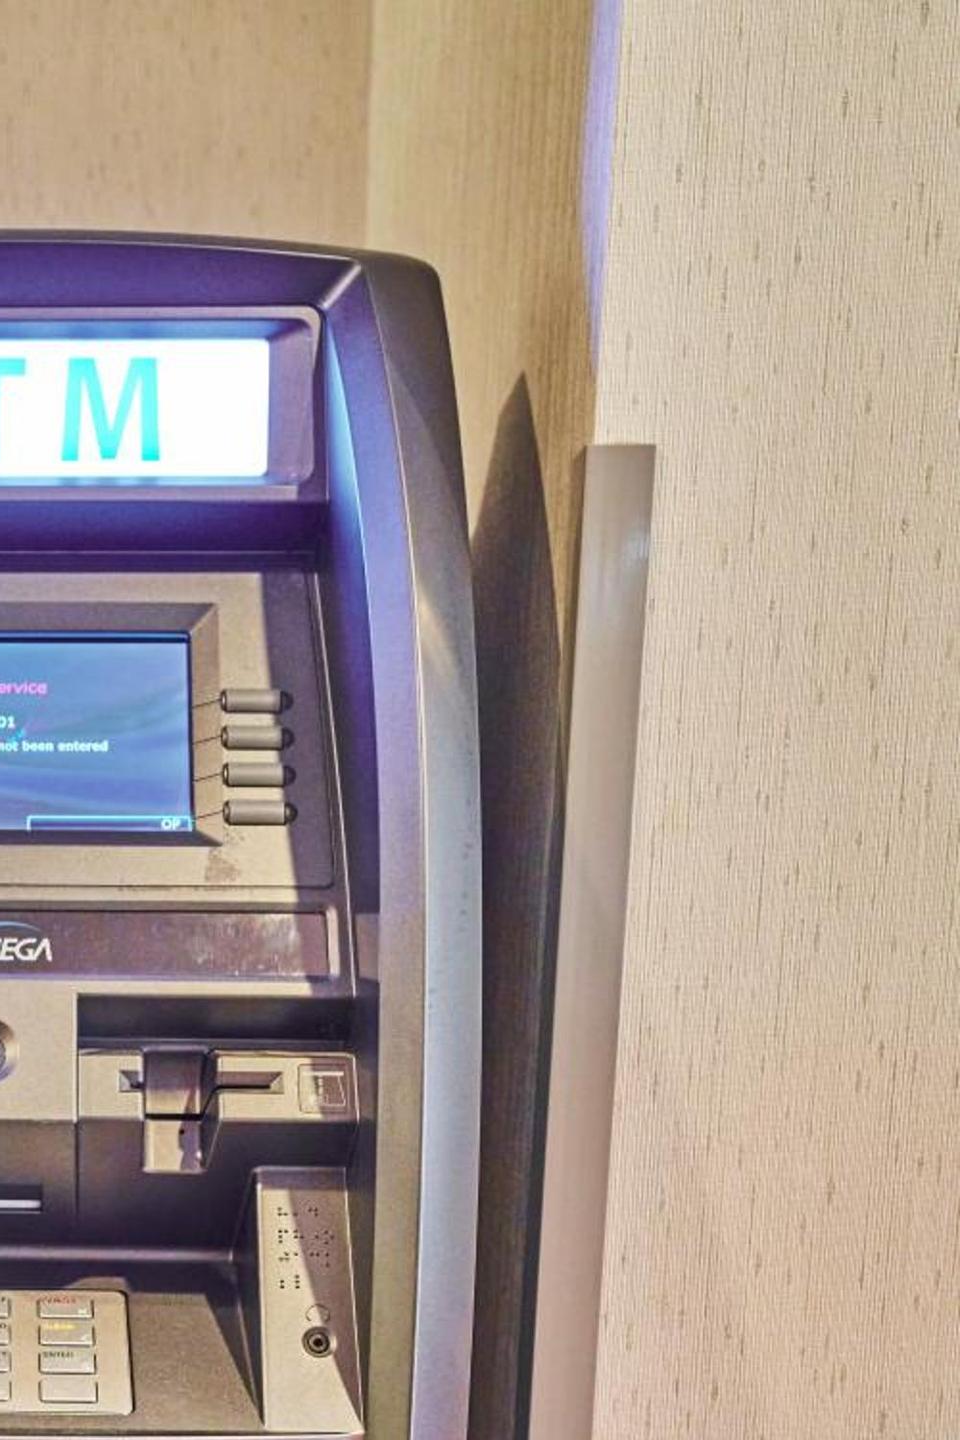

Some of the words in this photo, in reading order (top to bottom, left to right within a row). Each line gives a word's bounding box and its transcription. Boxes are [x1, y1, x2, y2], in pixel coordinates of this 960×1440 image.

[22, 739, 54, 752] been
[58, 739, 109, 752] entered
[161, 816, 181, 830] OP
